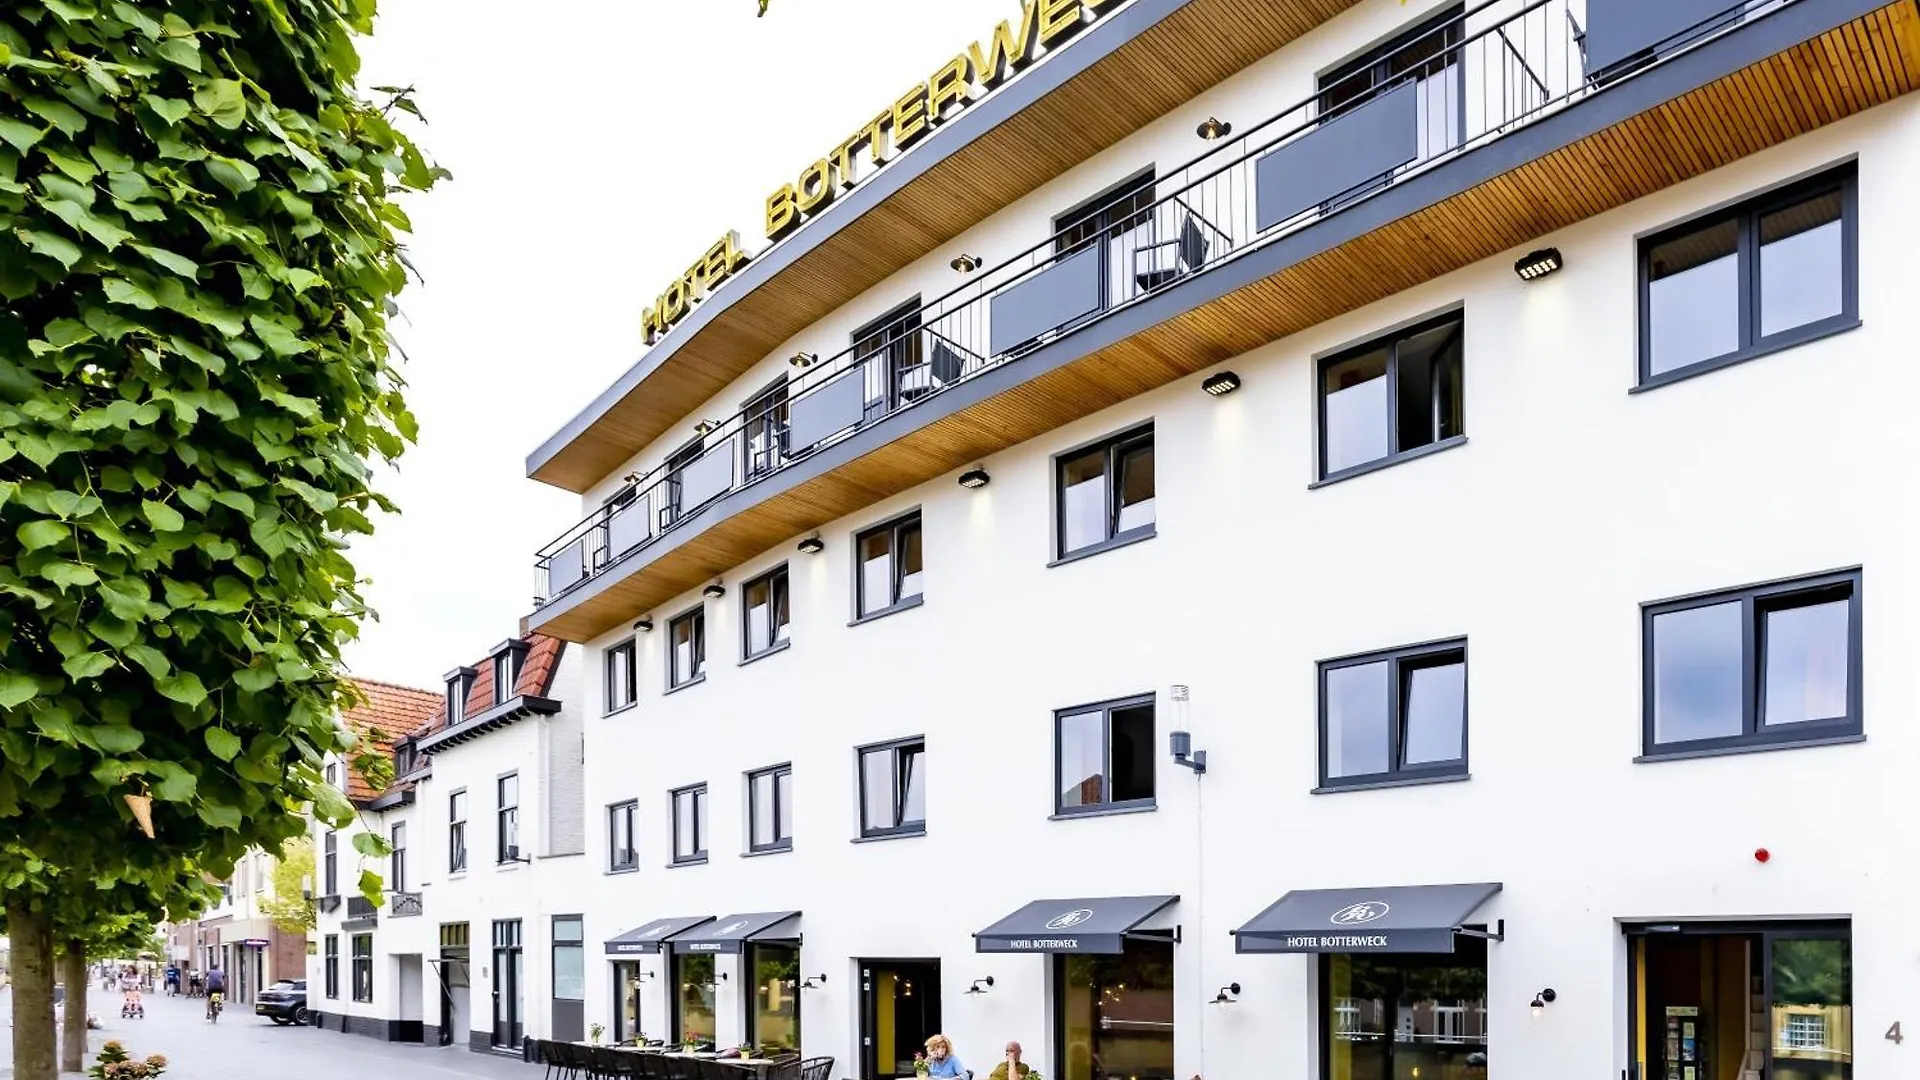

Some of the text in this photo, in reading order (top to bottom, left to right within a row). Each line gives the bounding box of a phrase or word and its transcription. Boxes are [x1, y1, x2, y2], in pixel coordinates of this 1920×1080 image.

[641, 0, 1112, 346] HOTEL BOTTERWE
[1287, 936, 1387, 947] HOTEL BOTTERWECK
[1885, 1021, 1904, 1045] 4
